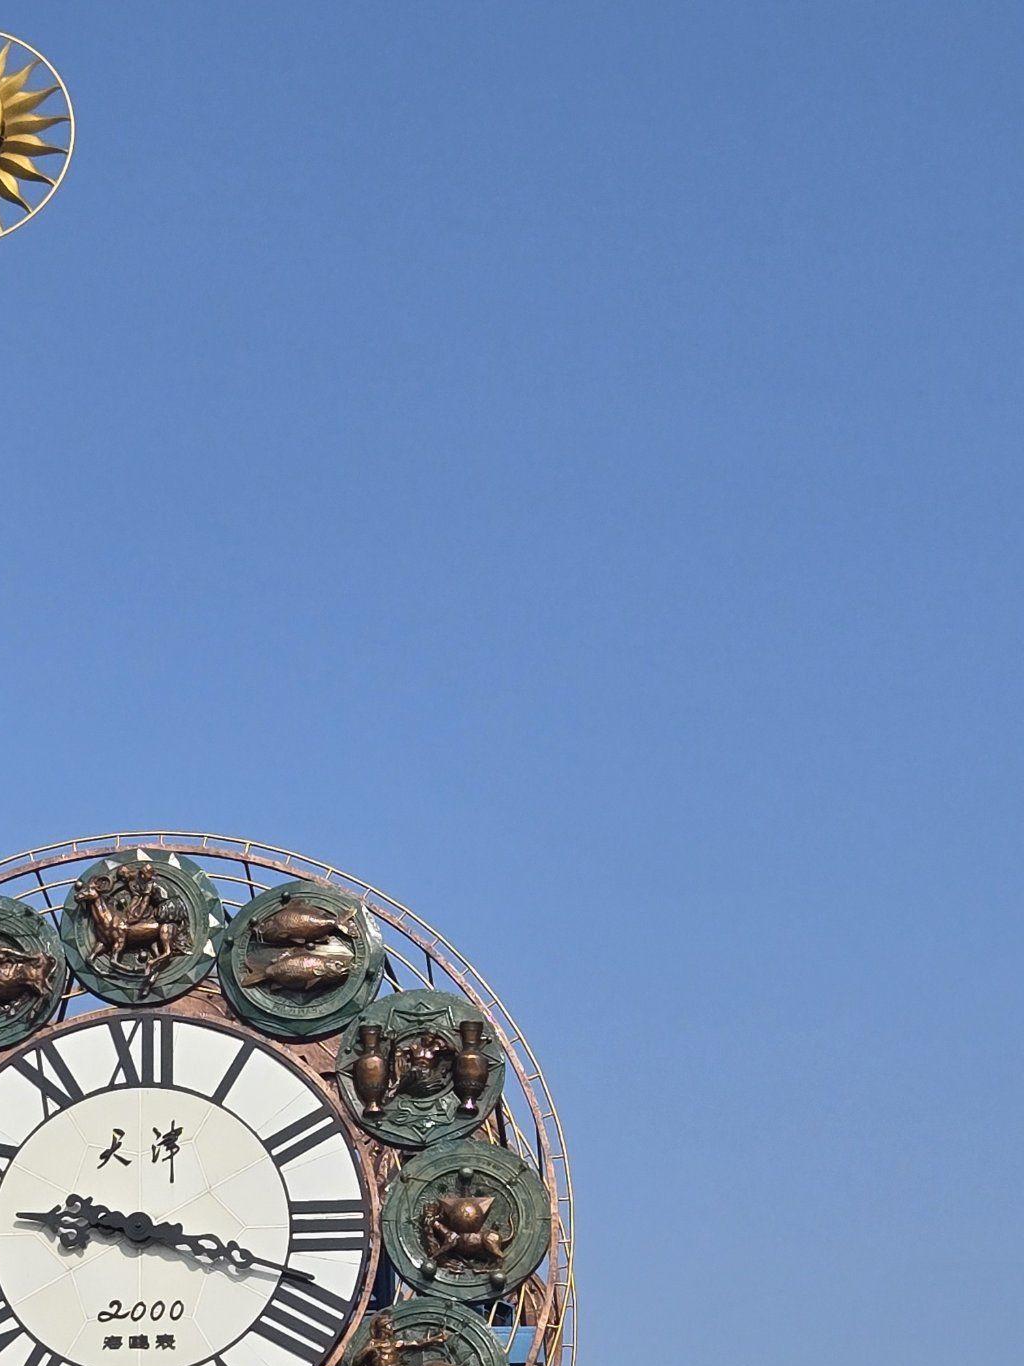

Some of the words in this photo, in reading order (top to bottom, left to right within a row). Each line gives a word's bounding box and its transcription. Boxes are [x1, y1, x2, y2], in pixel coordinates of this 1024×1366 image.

[13, 1039, 85, 1119] XI
[109, 1019, 173, 1086] XII
[97, 1120, 183, 1183] 天津
[289, 1200, 367, 1251] III
[97, 1299, 184, 1322] 2000
